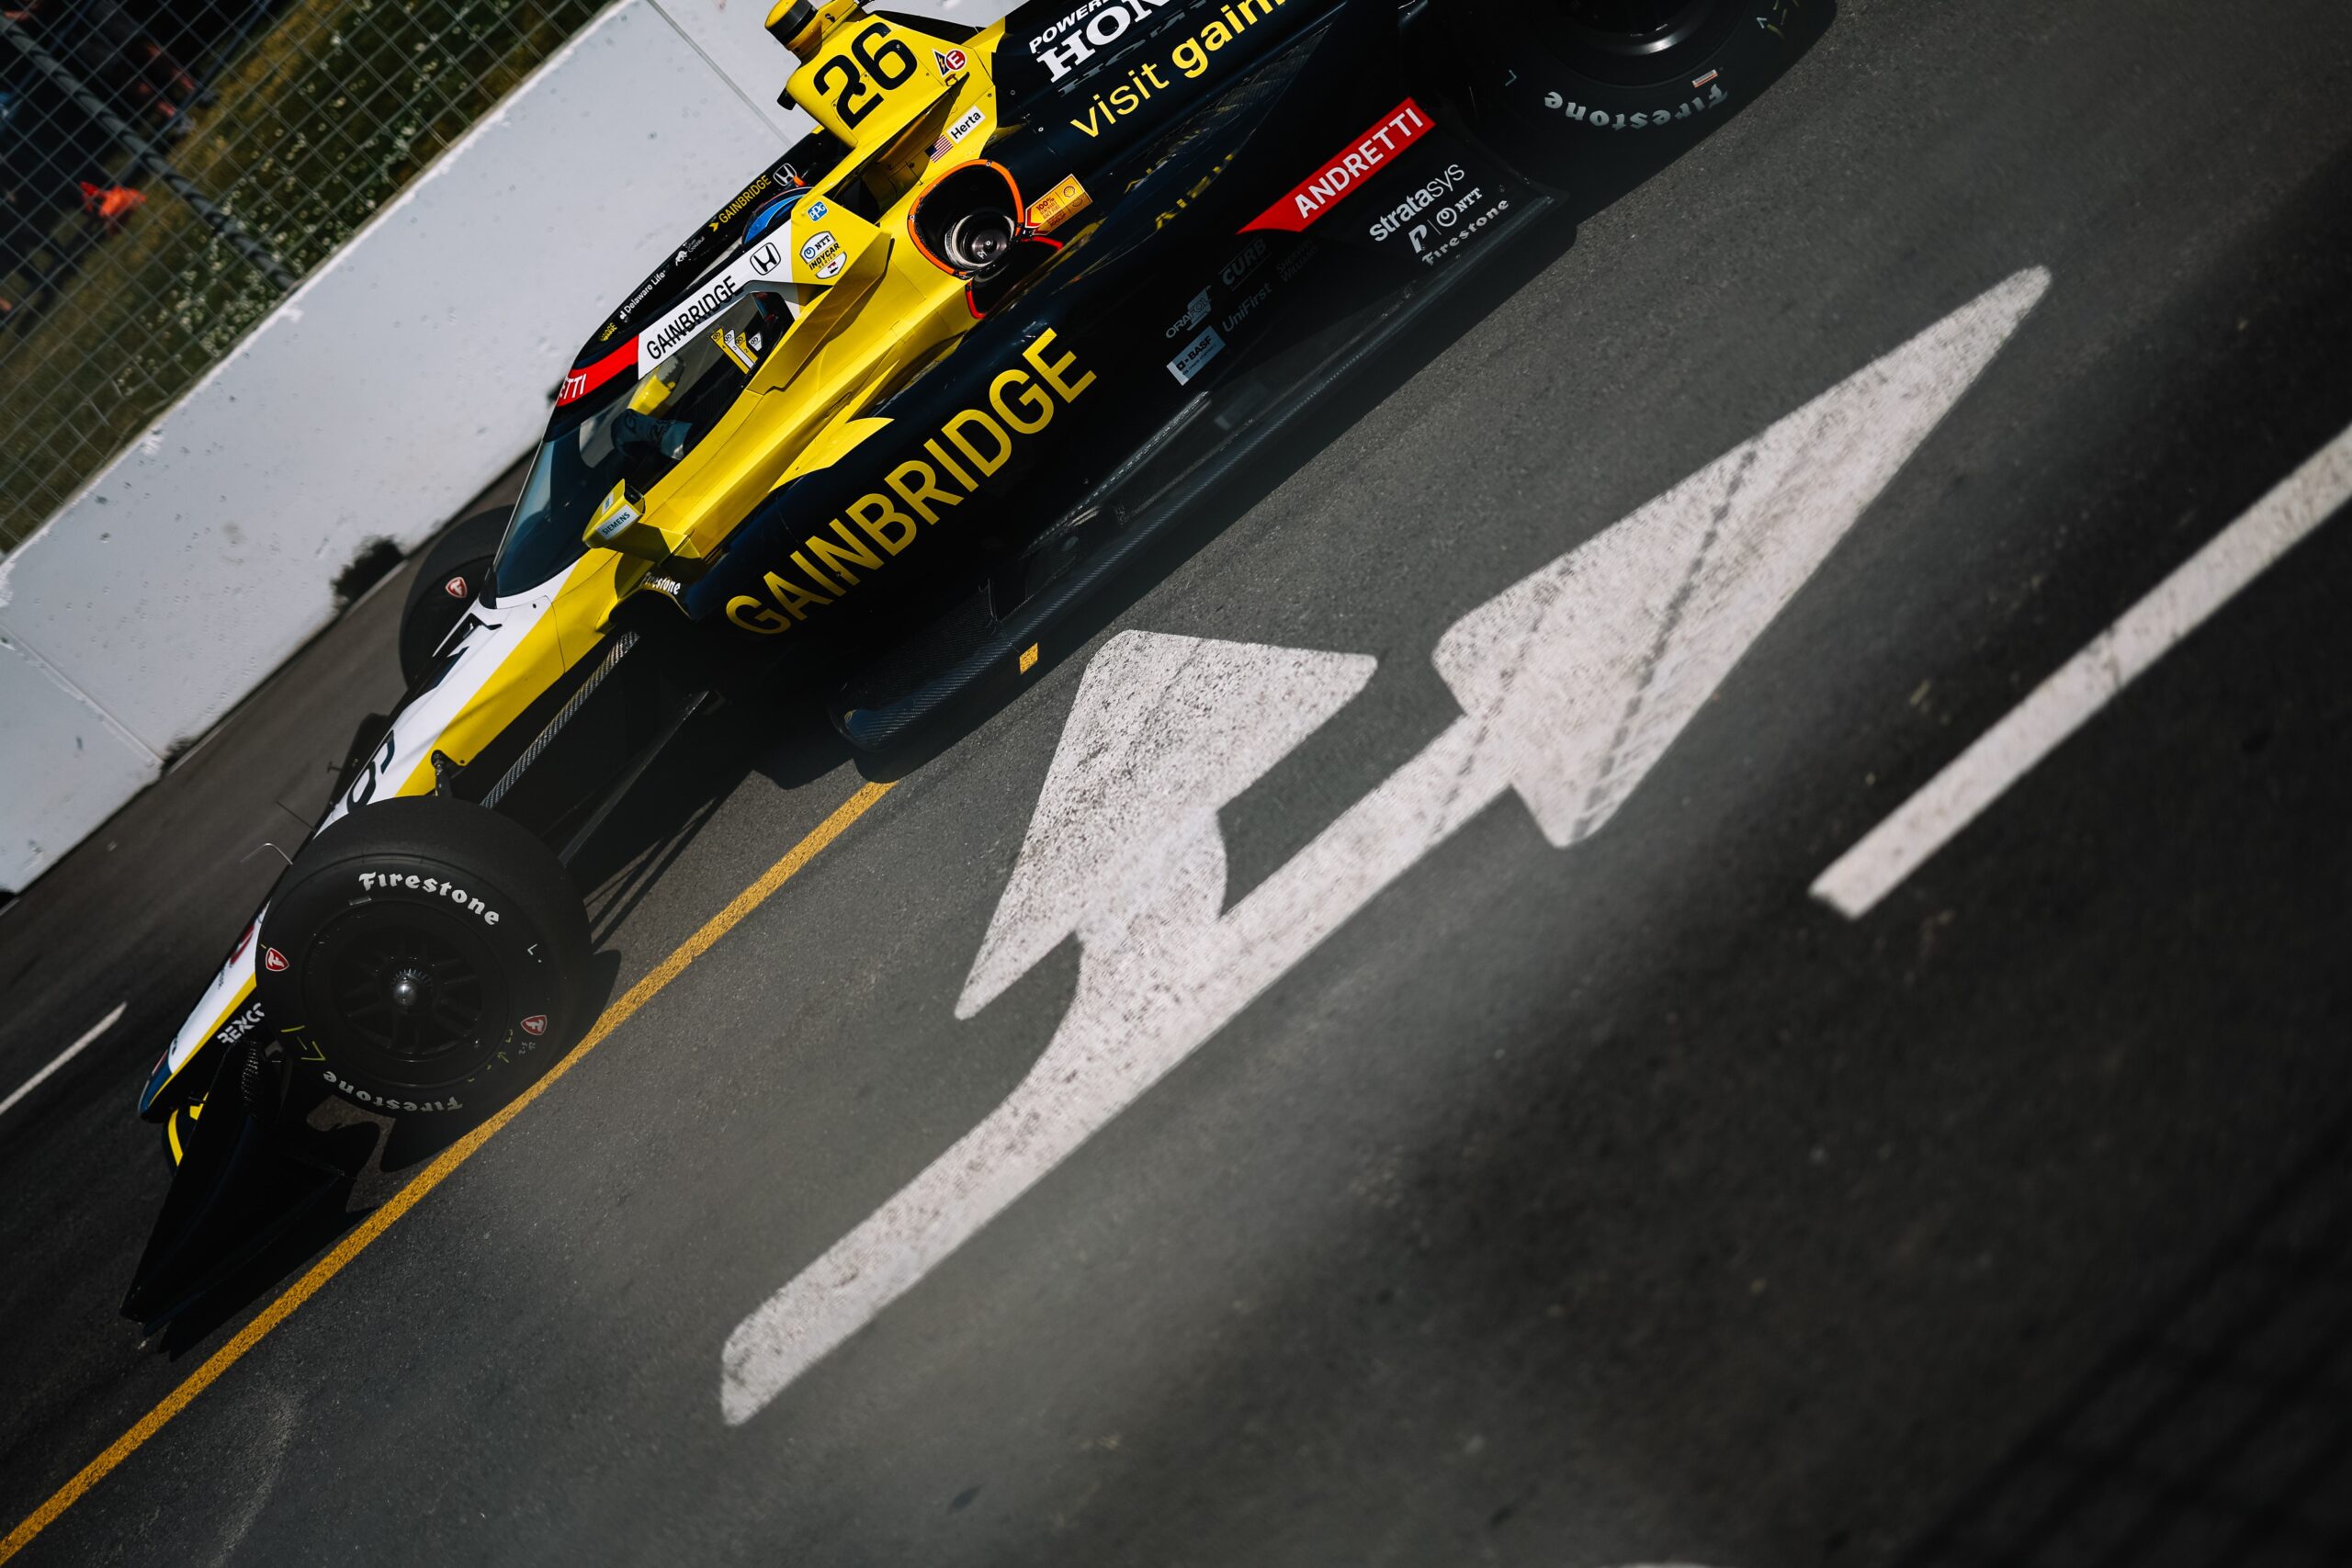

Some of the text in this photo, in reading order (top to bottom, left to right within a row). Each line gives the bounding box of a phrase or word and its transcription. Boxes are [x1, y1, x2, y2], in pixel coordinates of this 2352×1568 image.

[1029, 0, 1109, 54] POWER
[1036, 0, 1175, 83] HON
[813, 22, 918, 130] 26
[1069, 0, 1286, 139] visit gain
[950, 111, 982, 140] Herta
[1544, 84, 1728, 131] Firestone
[1294, 107, 1425, 220] ANDRETTI
[718, 175, 772, 225] GAINBRIDGE
[808, 202, 827, 220] PPG
[1035, 196, 1055, 211] 100%
[1369, 164, 1465, 243] stratasys
[1455, 186, 1484, 213] NTT
[808, 243, 841, 270] INDYCAR
[815, 235, 831, 250] NTT
[1421, 198, 1510, 266] Firestone
[1222, 237, 1268, 287] CURB
[624, 271, 665, 314] Delaware Life
[646, 275, 741, 360] GAINBRIDGE
[1222, 279, 1272, 333] UniFirst
[1188, 335, 1213, 361] BASF
[725, 326, 1098, 636] GAINBRIDGE
[602, 512, 630, 535] SIEMENS
[359, 871, 501, 927] Firestone
[322, 1070, 463, 1113] Firestone
